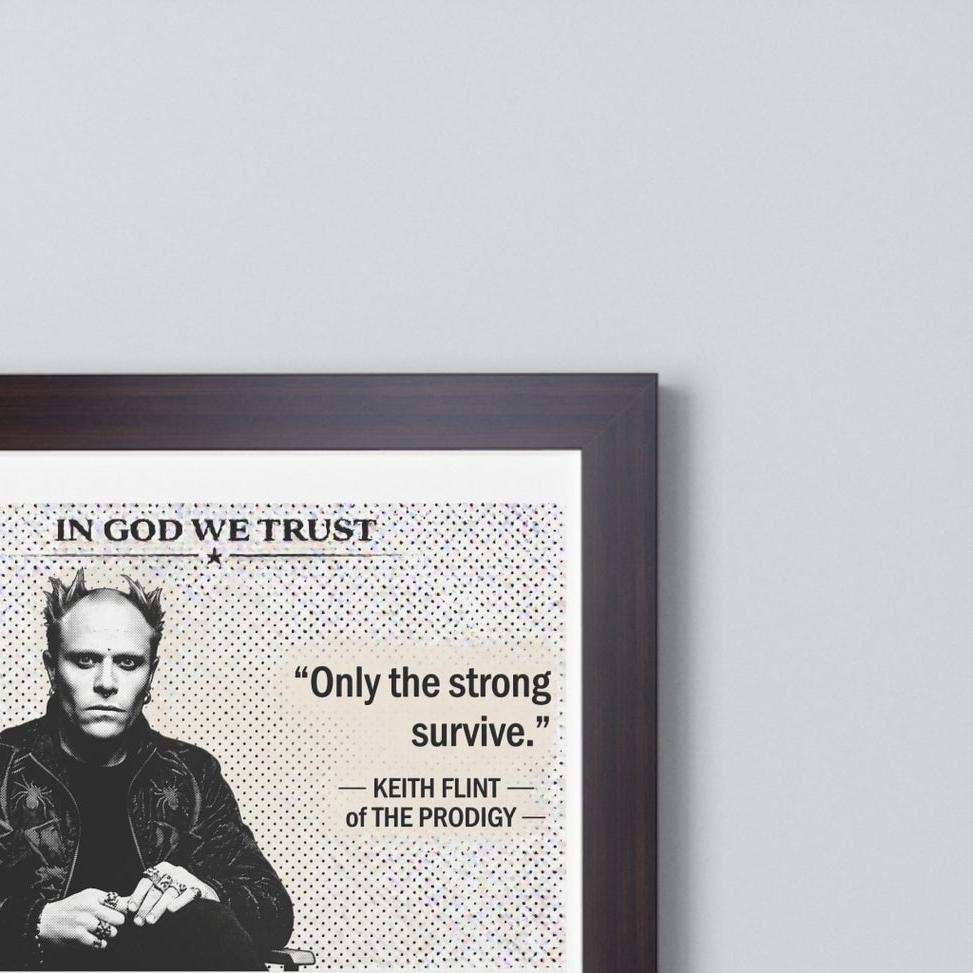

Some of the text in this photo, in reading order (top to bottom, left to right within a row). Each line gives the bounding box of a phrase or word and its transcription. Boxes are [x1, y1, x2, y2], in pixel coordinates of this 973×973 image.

[54, 518, 378, 542] IN GOD WE TRUST
[294, 665, 552, 706] “Only the strong
[411, 715, 550, 748] survive.”
[373, 777, 502, 798] KEITH FLINT
[345, 806, 517, 828] of THE PRODIGY
